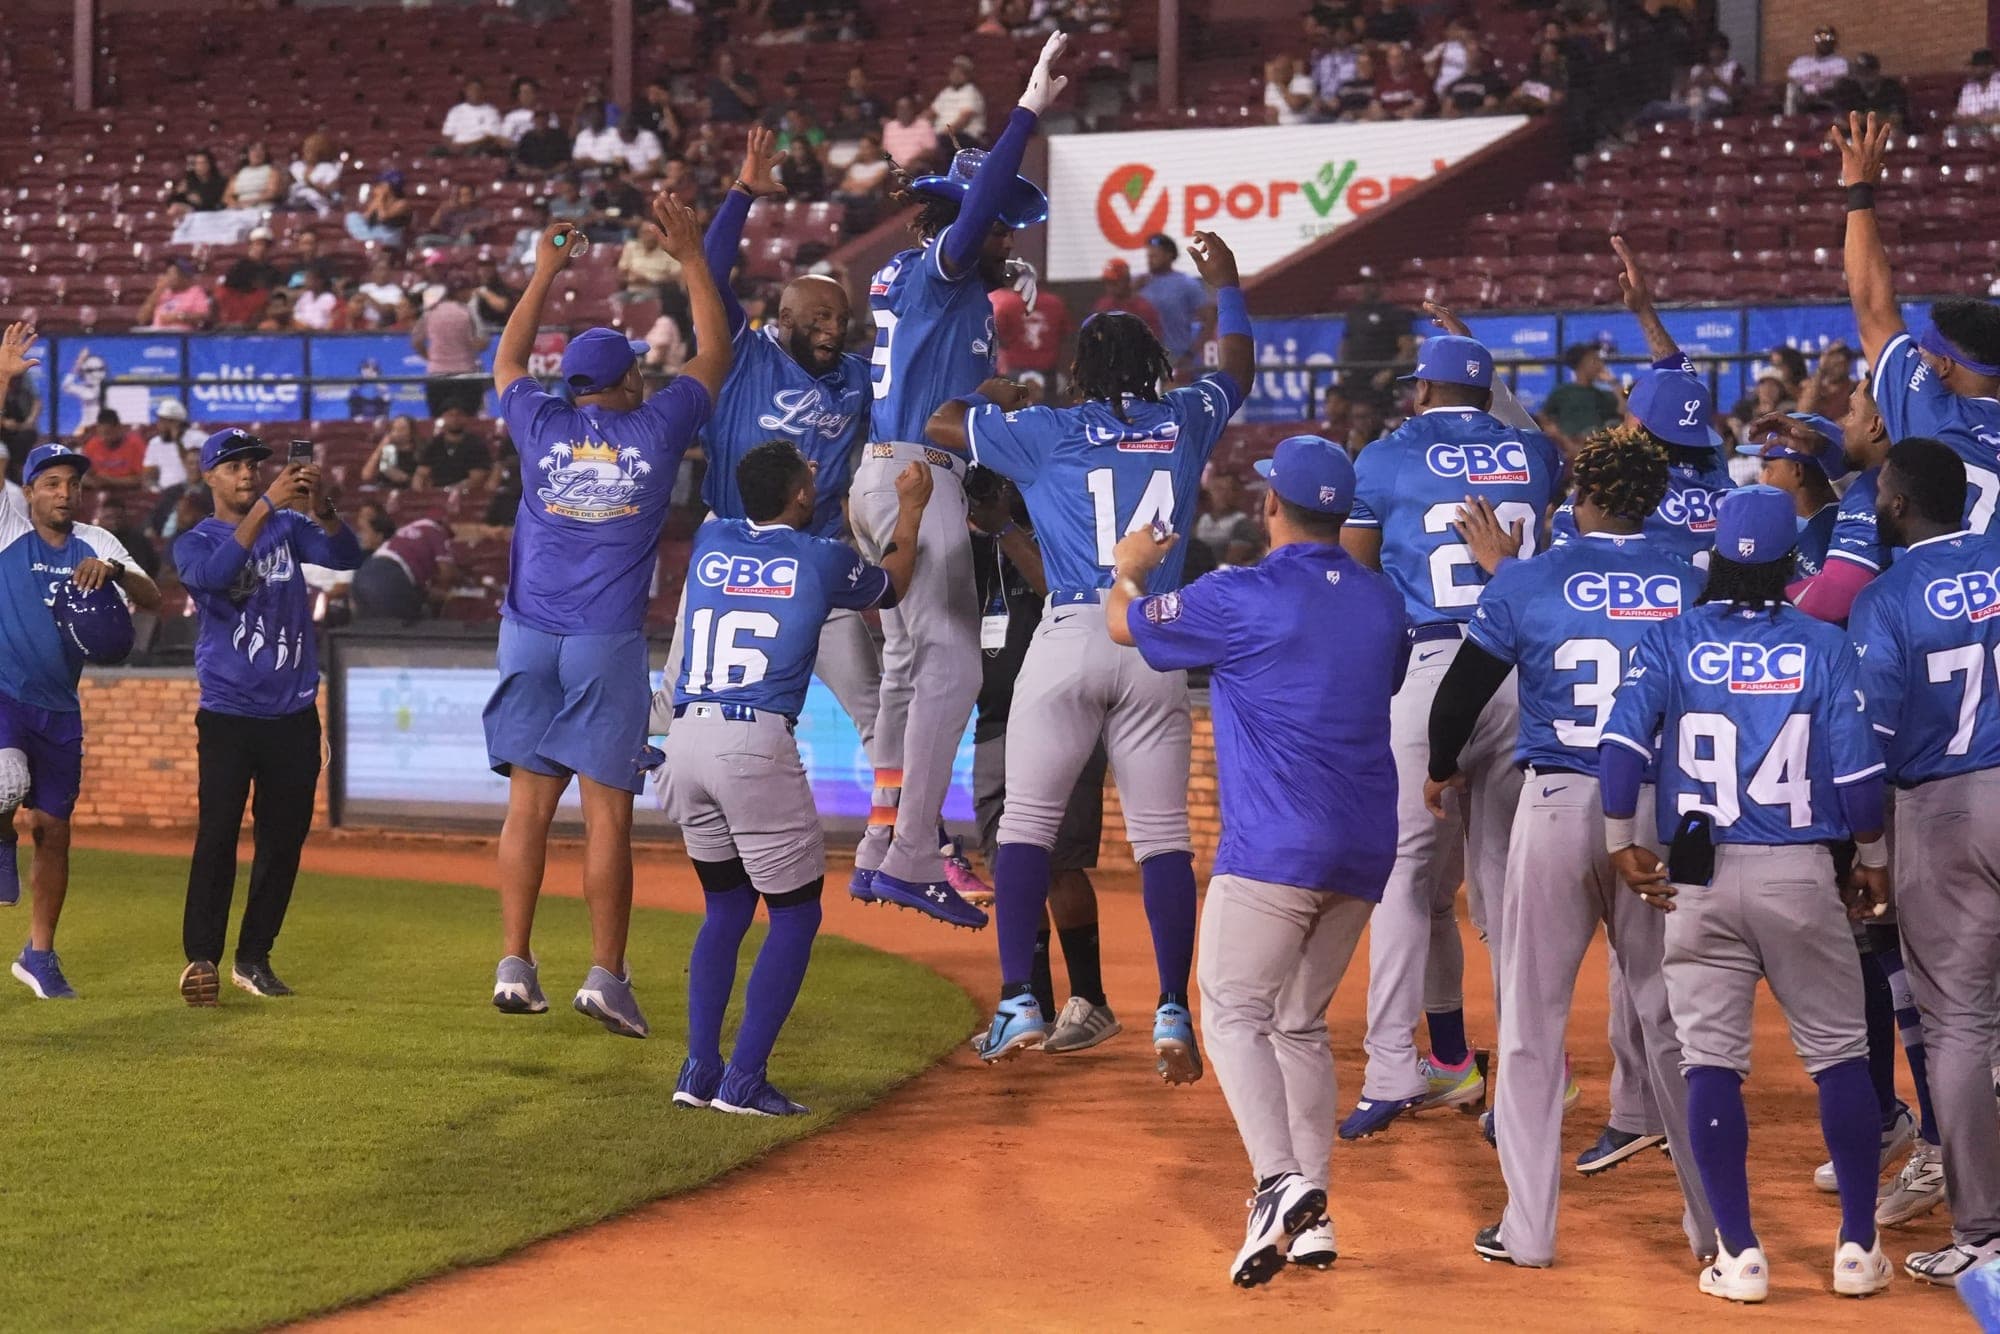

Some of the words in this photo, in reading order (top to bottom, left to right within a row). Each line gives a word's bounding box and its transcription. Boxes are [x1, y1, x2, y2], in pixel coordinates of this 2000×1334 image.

[1427, 443, 1528, 476] GBC
[1477, 473, 1525, 482] FARMACIAS
[556, 507, 581, 517] REYES
[581, 511, 597, 519] DEL
[598, 507, 627, 518] CARIBE
[1086, 467, 1175, 567] 14
[697, 552, 797, 588] GBC
[733, 587, 786, 596] FARMACIAS
[1565, 573, 1680, 611] GBC
[1925, 567, 2000, 619] GB
[1619, 609, 1674, 618] FARMACIAS
[684, 607, 780, 696] 16
[1690, 644, 1804, 683] GBC
[1740, 682, 1796, 691] FARMACIAS
[1926, 643, 2000, 756] 7
[1677, 711, 1813, 829] 94
